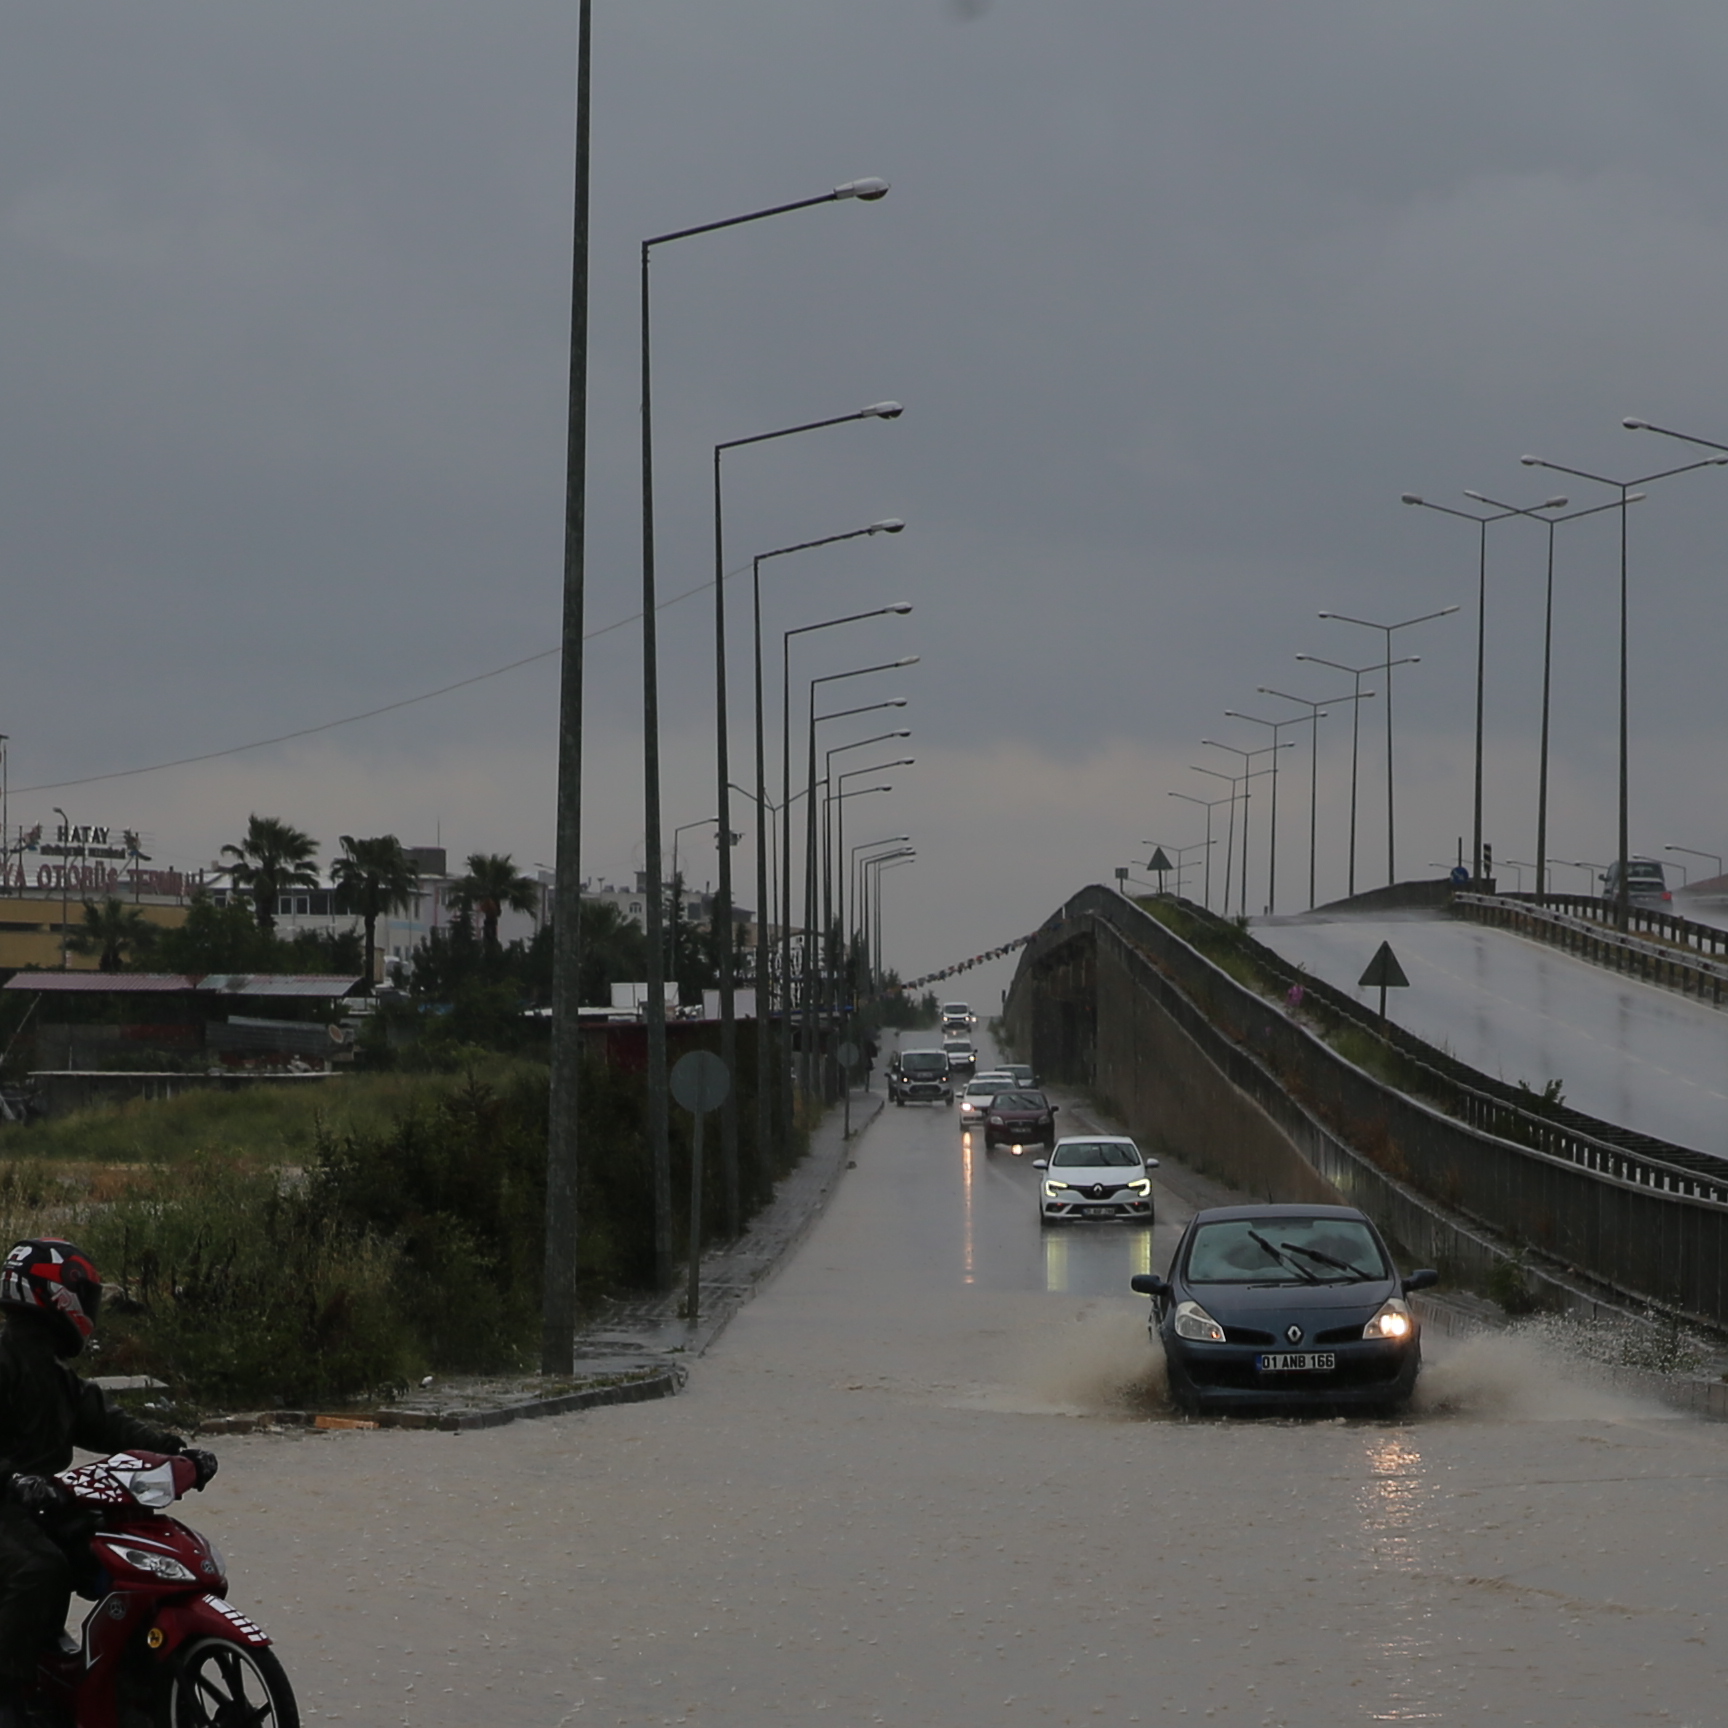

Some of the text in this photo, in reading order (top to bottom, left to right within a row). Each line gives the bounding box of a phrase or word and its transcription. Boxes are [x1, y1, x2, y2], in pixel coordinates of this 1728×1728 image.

[57, 825, 110, 844] HATAY
[1262, 1354, 1334, 1369] 01 ANB 166
